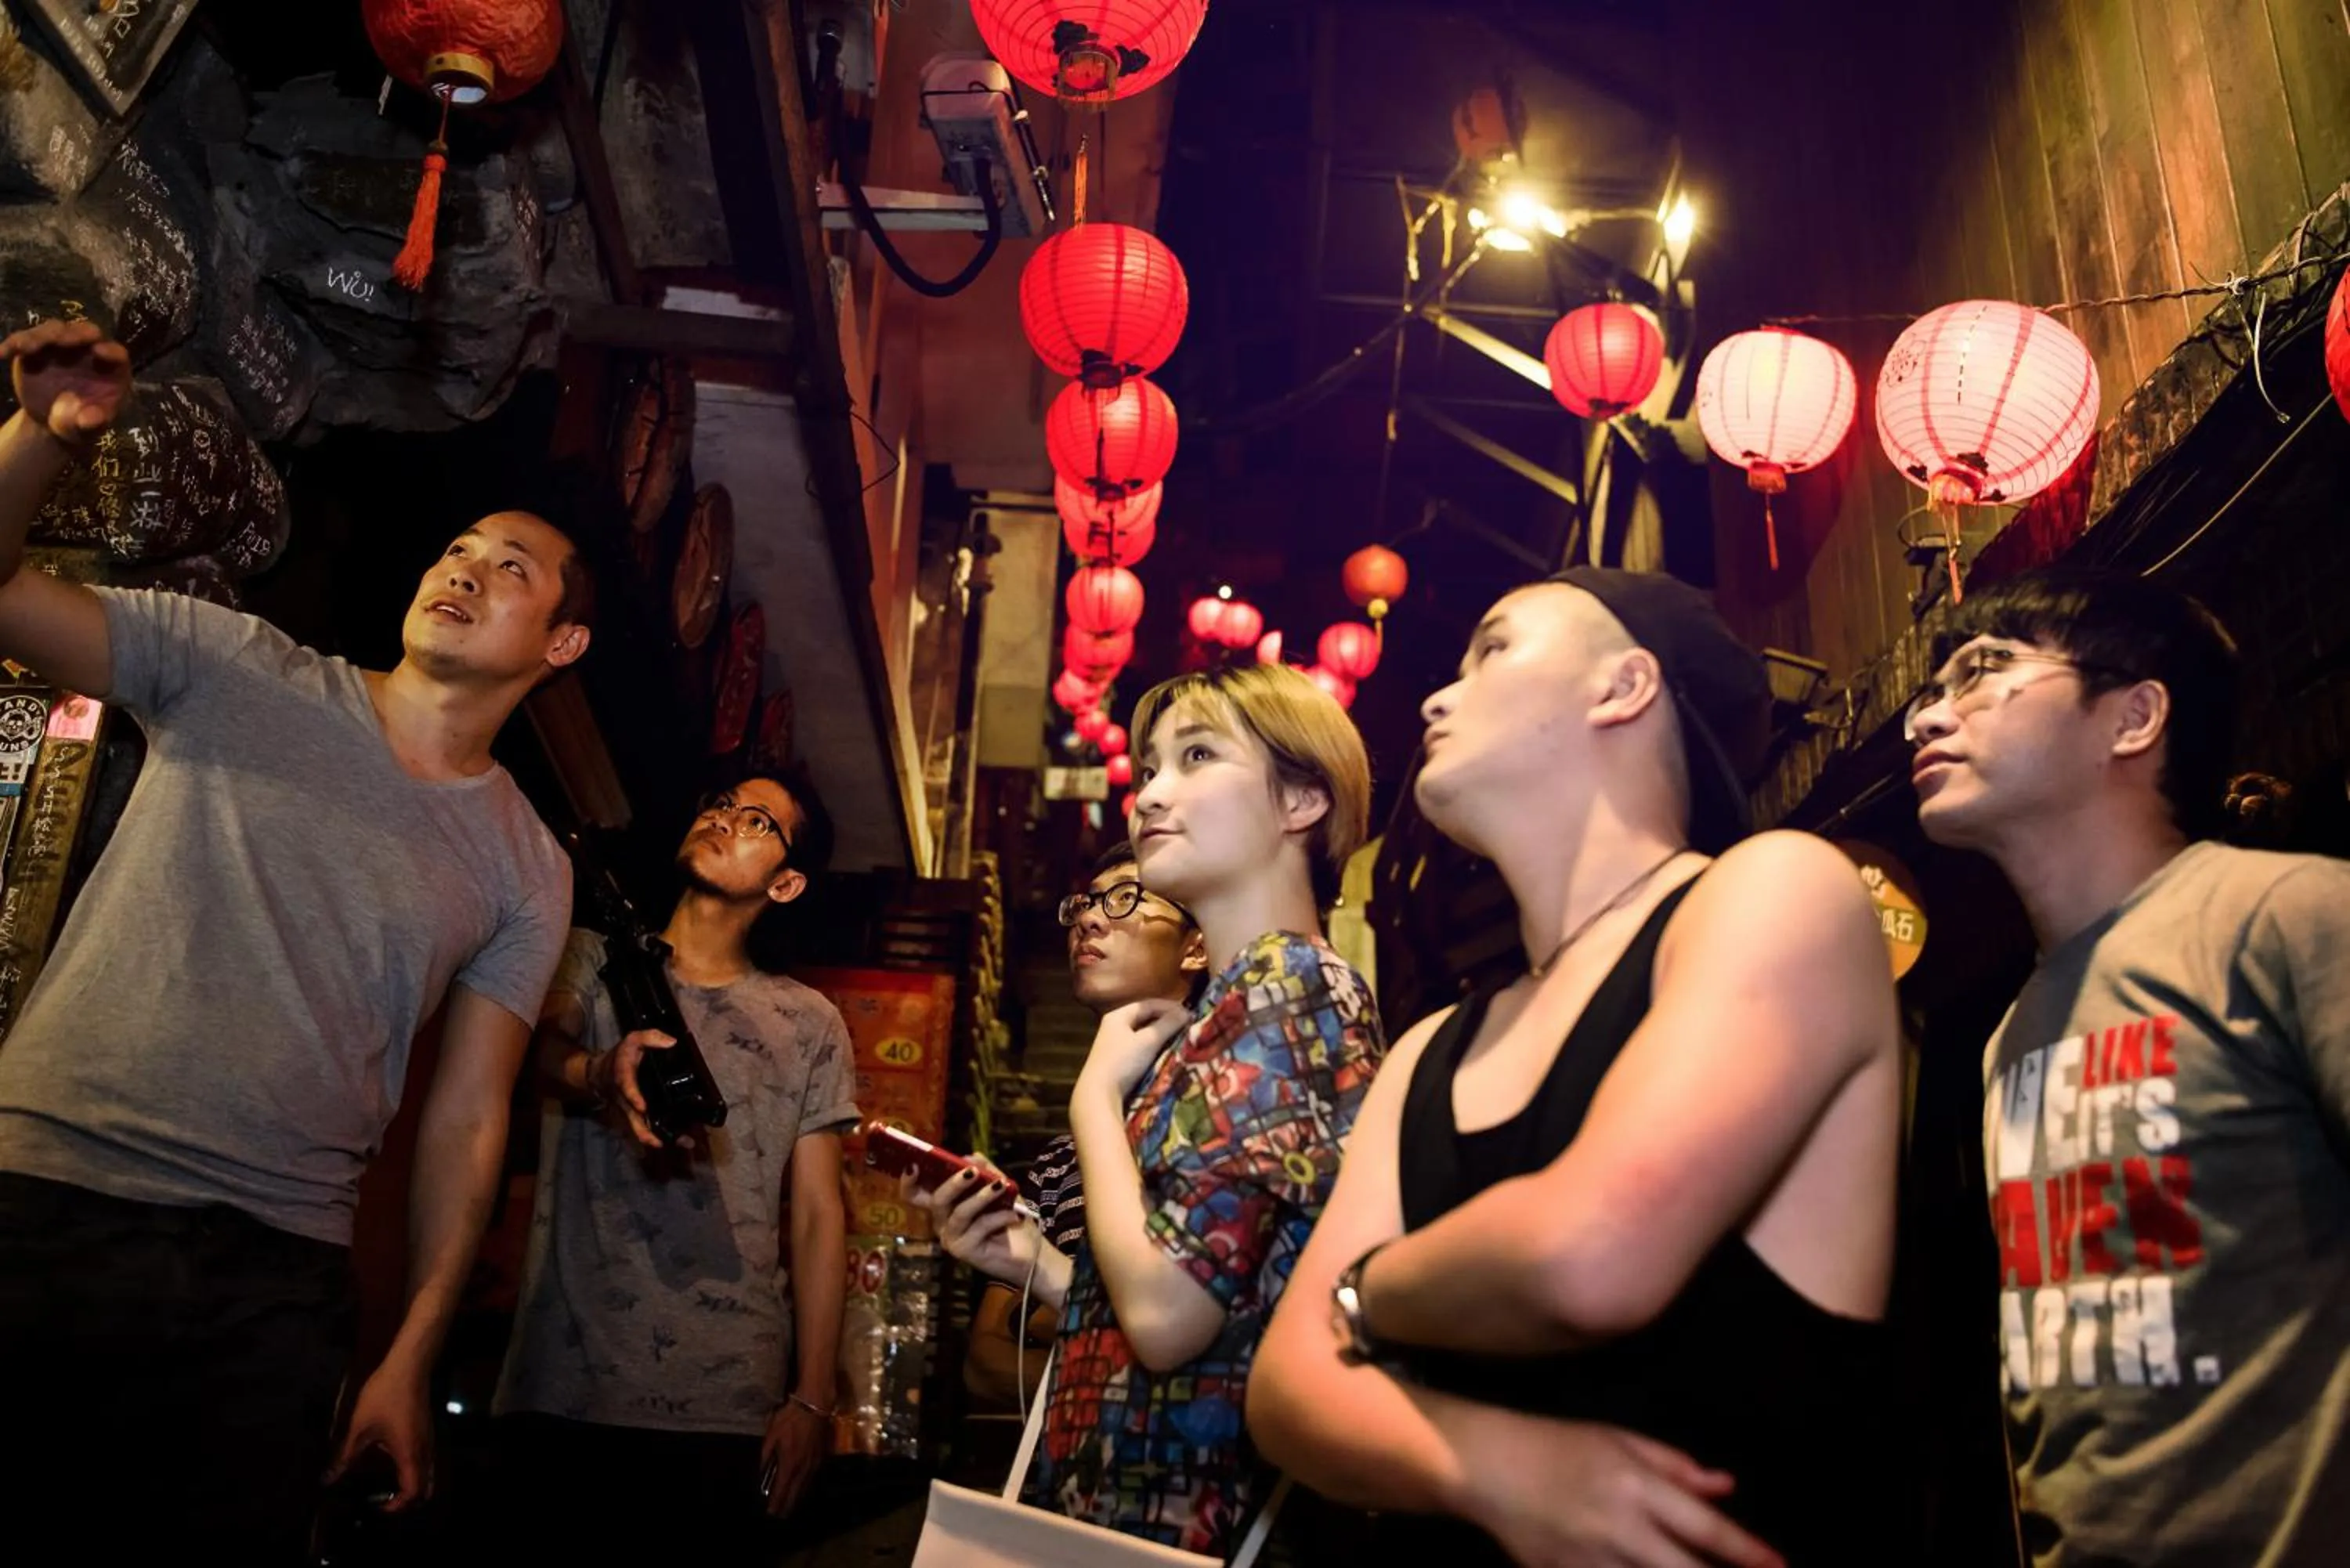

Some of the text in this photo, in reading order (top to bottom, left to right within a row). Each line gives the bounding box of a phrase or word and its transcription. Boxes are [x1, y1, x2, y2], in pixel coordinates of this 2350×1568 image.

[884, 1041, 914, 1061] 40
[2084, 1016, 2178, 1087] LIKE
[2077, 1077, 2181, 1165] IT'S
[870, 1207, 898, 1226] 50
[1990, 1155, 2205, 1287] AVEN
